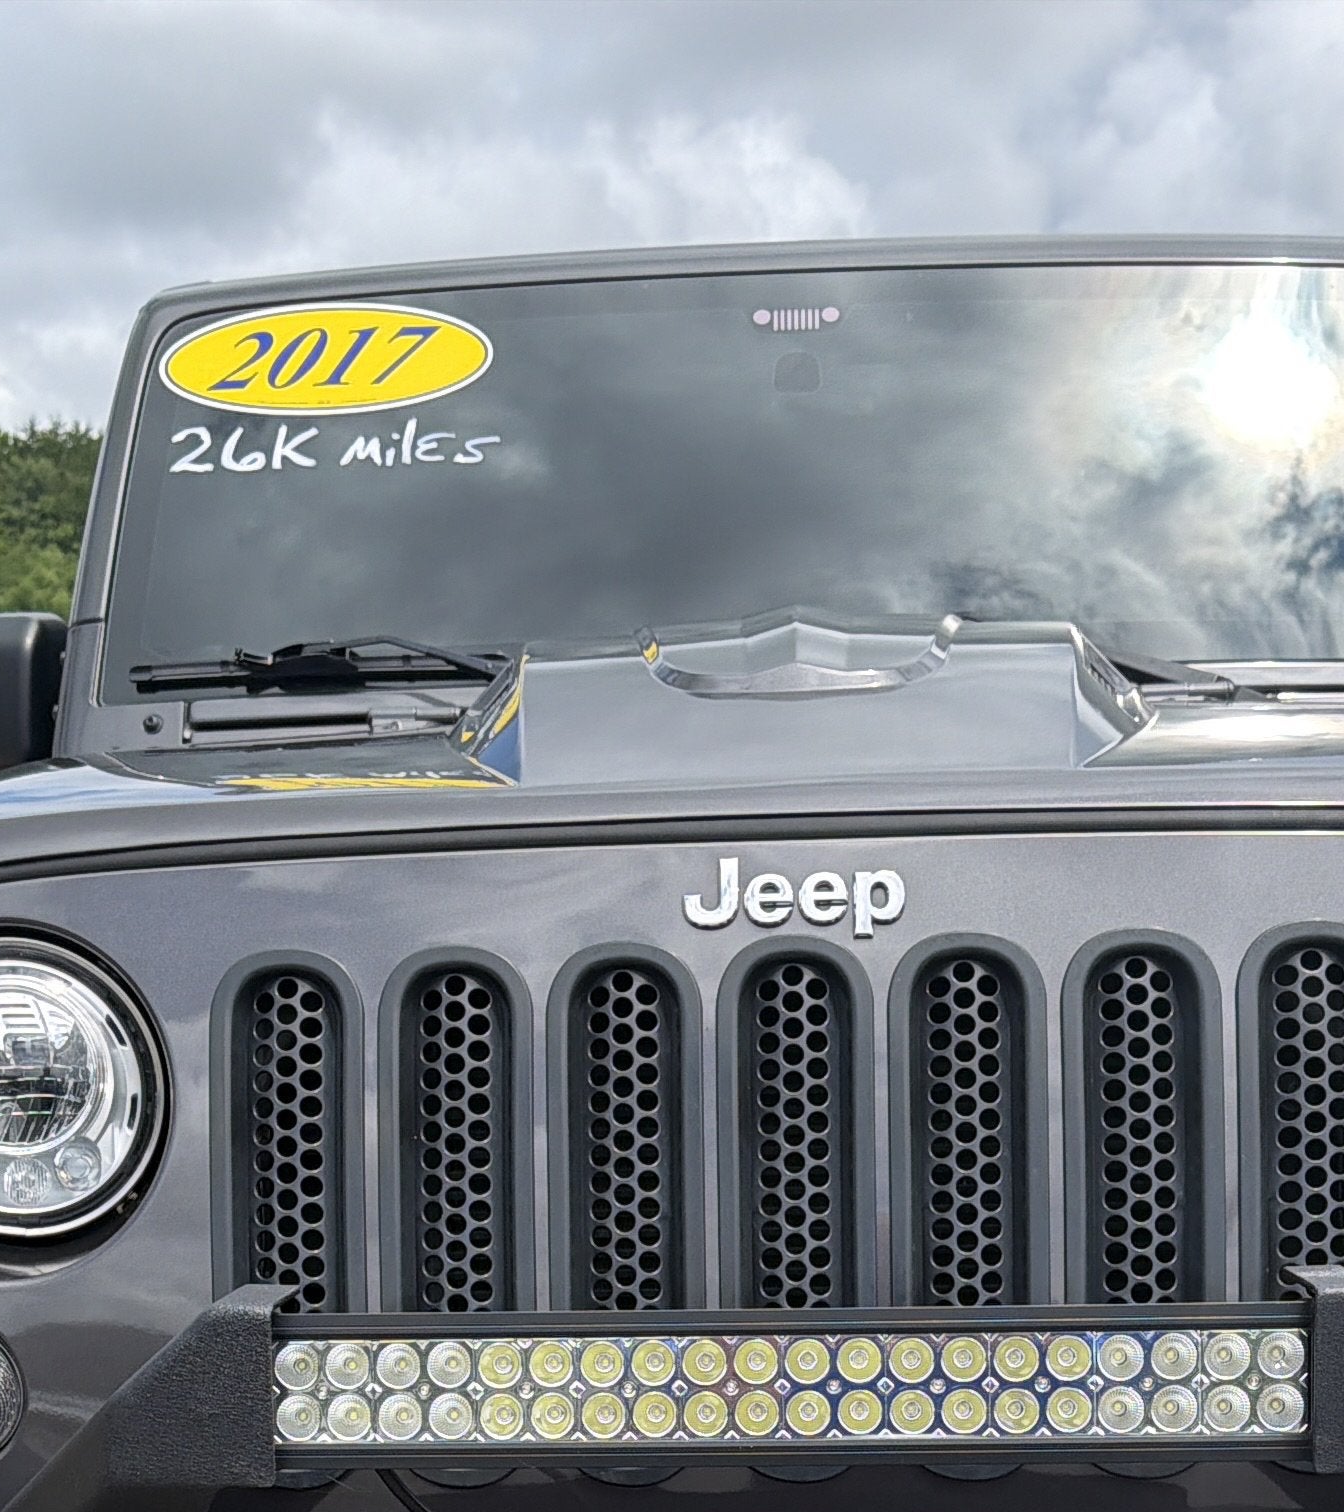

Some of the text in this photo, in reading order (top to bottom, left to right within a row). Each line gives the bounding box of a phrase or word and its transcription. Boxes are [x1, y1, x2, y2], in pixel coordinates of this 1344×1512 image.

[207, 324, 443, 392] 2017
[168, 424, 319, 474] 26K
[682, 857, 906, 939] Jeep
